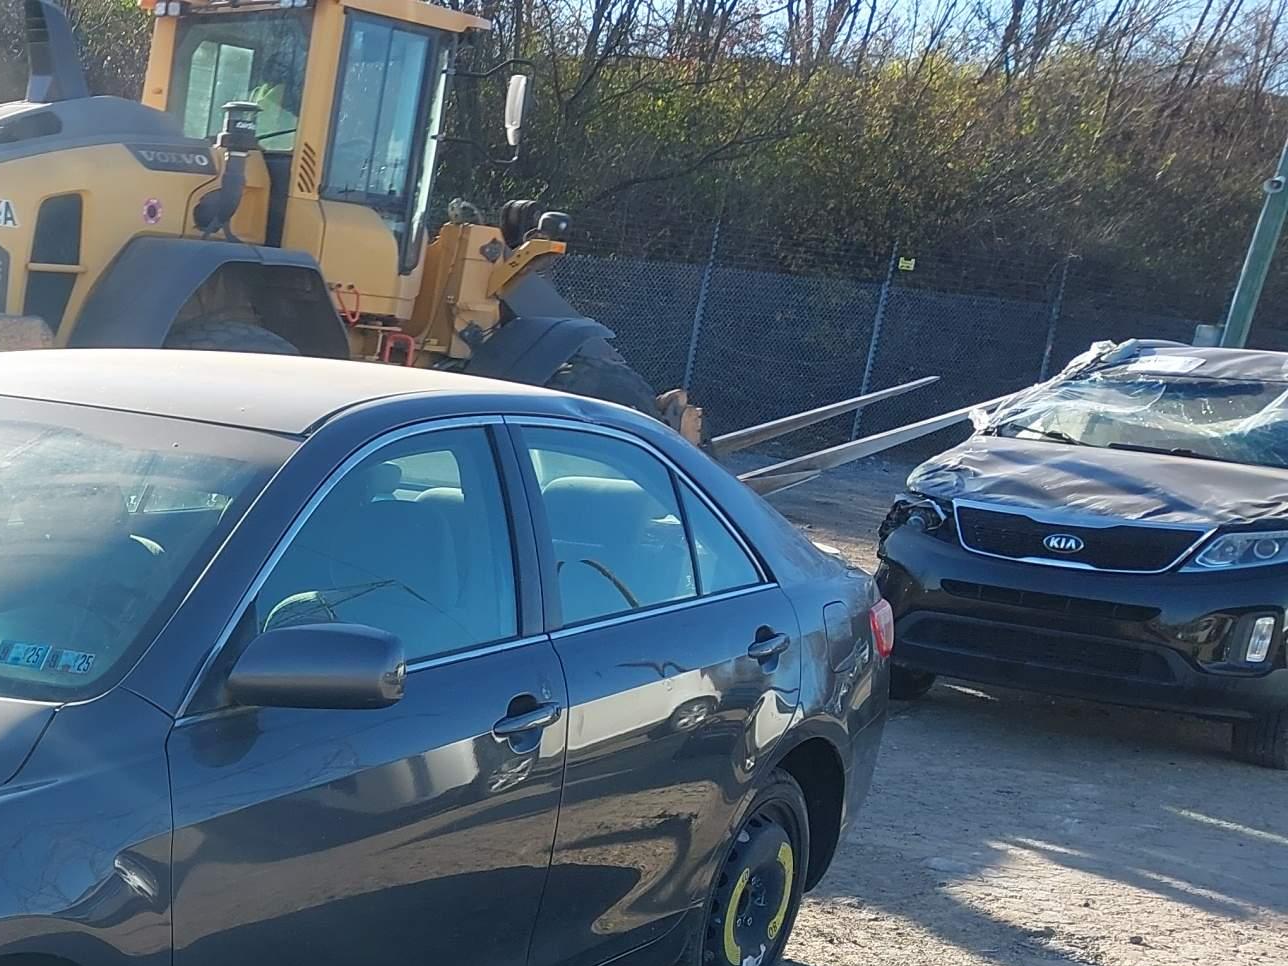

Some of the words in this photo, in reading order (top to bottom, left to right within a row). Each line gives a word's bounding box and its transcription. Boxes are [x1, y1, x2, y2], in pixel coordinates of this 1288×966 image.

[137, 150, 209, 167] VOLVO
[1049, 536, 1076, 550] KIA
[25, 647, 44, 665] 25
[76, 654, 94, 672] 25
